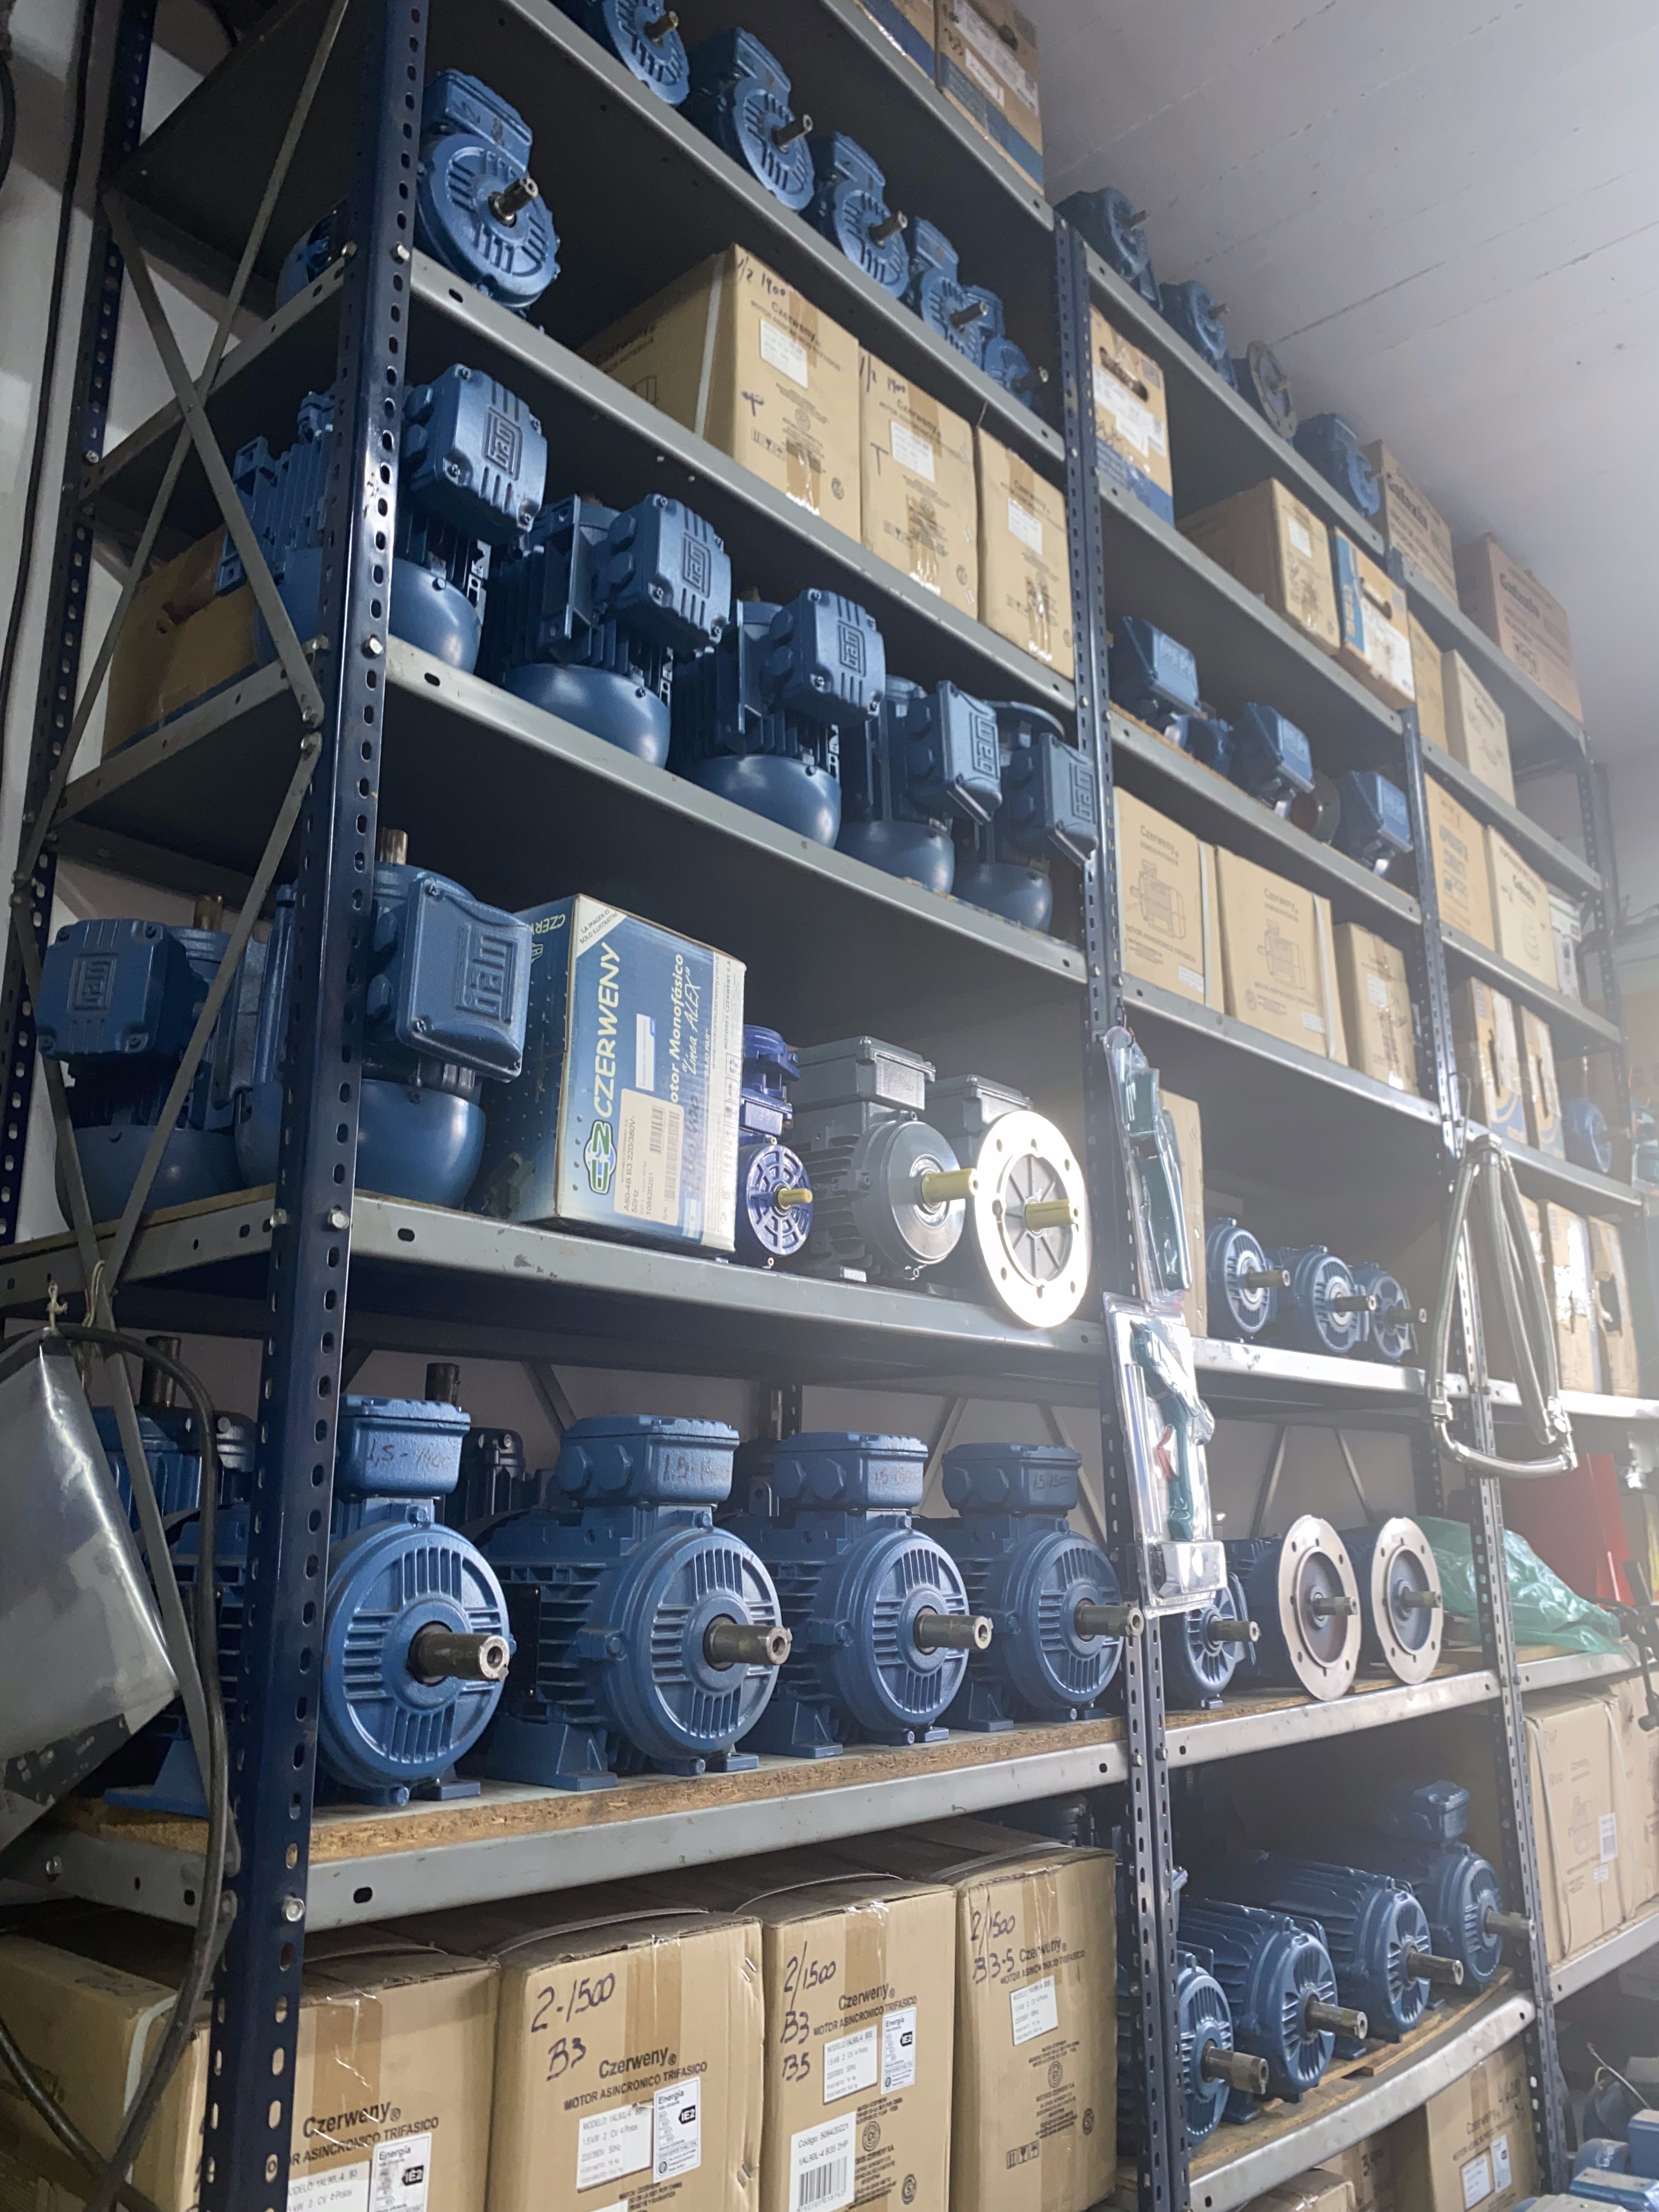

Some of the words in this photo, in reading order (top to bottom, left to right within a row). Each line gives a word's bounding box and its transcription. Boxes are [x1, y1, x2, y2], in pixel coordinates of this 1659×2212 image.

[669, 953, 685, 1060] Monofásico
[594, 941, 620, 1118] CZERWENY
[669, 1063, 681, 1103] otor
[626, 1163, 633, 1176] B3
[631, 1189, 639, 1214] 50Hz
[1000, 1971, 1021, 1984] MOTOR
[780, 2010, 810, 2045] B3
[814, 2020, 838, 2036] MOTOR
[839, 2006, 884, 2028] ASINCRONICO
[885, 1995, 917, 2013] TRIFASICO
[545, 2036, 587, 2082] B3
[564, 2091, 598, 2111] MOTOR
[600, 2074, 662, 2100] ASINCRONICO
[663, 2061, 708, 2083] TRIFASICO
[383, 2116, 439, 2140] TRIFASICO
